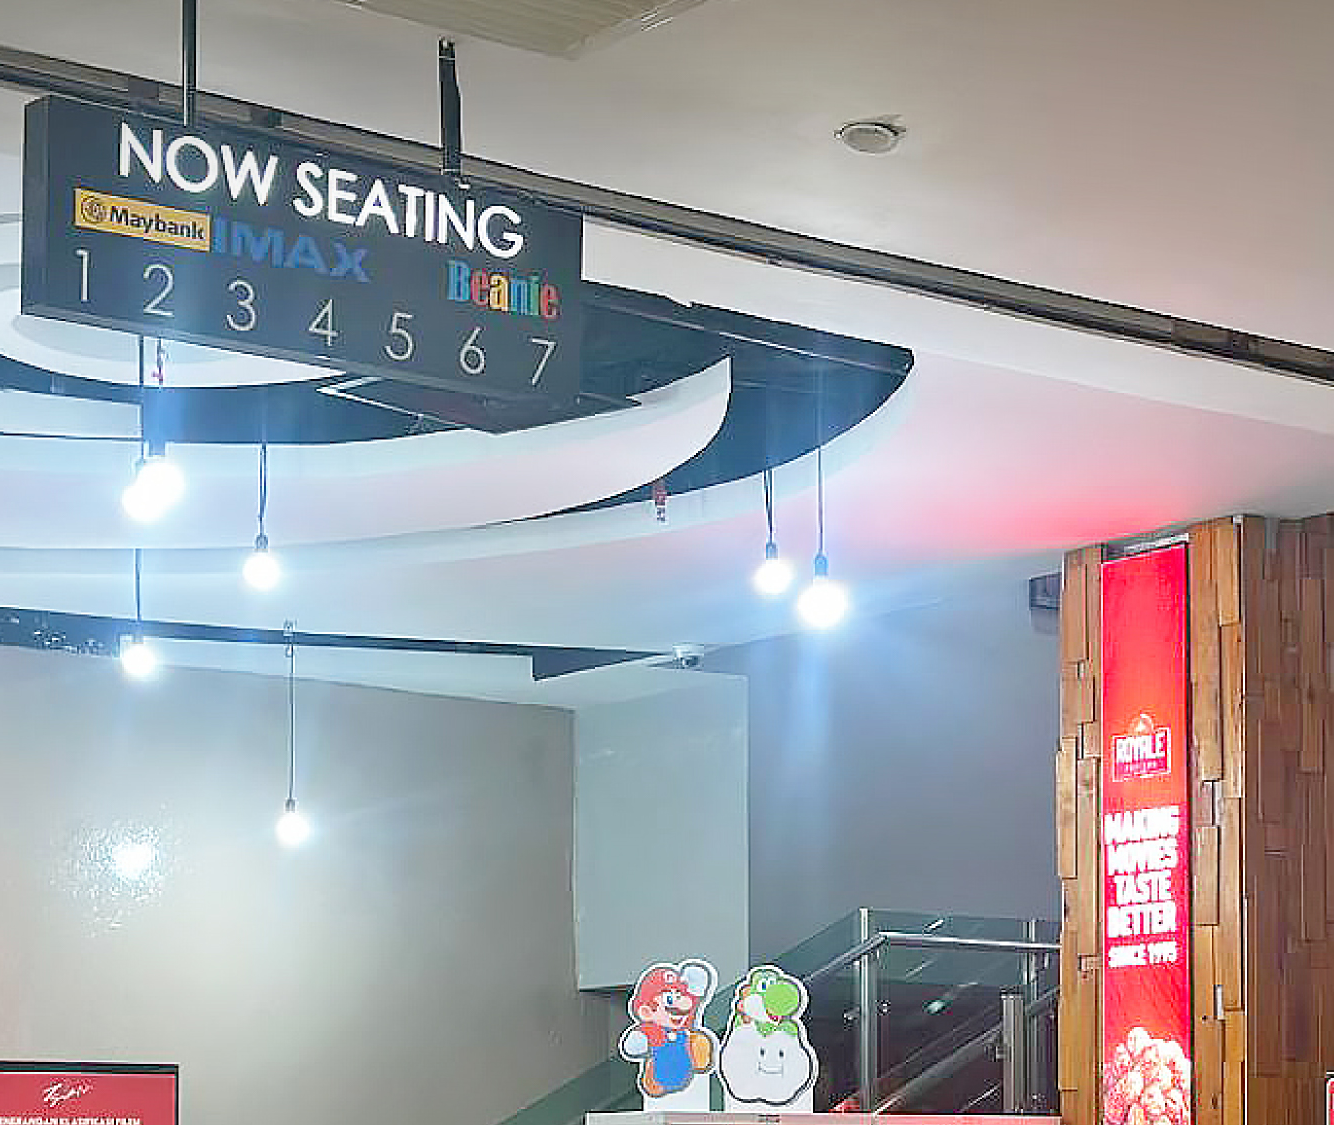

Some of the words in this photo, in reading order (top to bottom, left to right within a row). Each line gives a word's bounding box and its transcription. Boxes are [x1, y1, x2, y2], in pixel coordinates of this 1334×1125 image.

[118, 121, 279, 206] NOW
[292, 160, 525, 260] SEATING
[110, 205, 204, 242] Maybank
[213, 214, 371, 284] IMAX
[447, 260, 561, 320] Beanie
[75, 249, 89, 301] 1
[142, 263, 175, 317] 2
[226, 281, 257, 332] 3
[308, 298, 339, 347] 4
[384, 313, 414, 362] 5
[459, 327, 486, 376] 6
[530, 338, 557, 386] 7
[1116, 734, 1165, 762] ROYALE
[1104, 806, 1179, 845] MAKING
[1107, 837, 1178, 876] MOVIES
[1114, 870, 1172, 906] TASTE
[1107, 900, 1177, 938] BETTER
